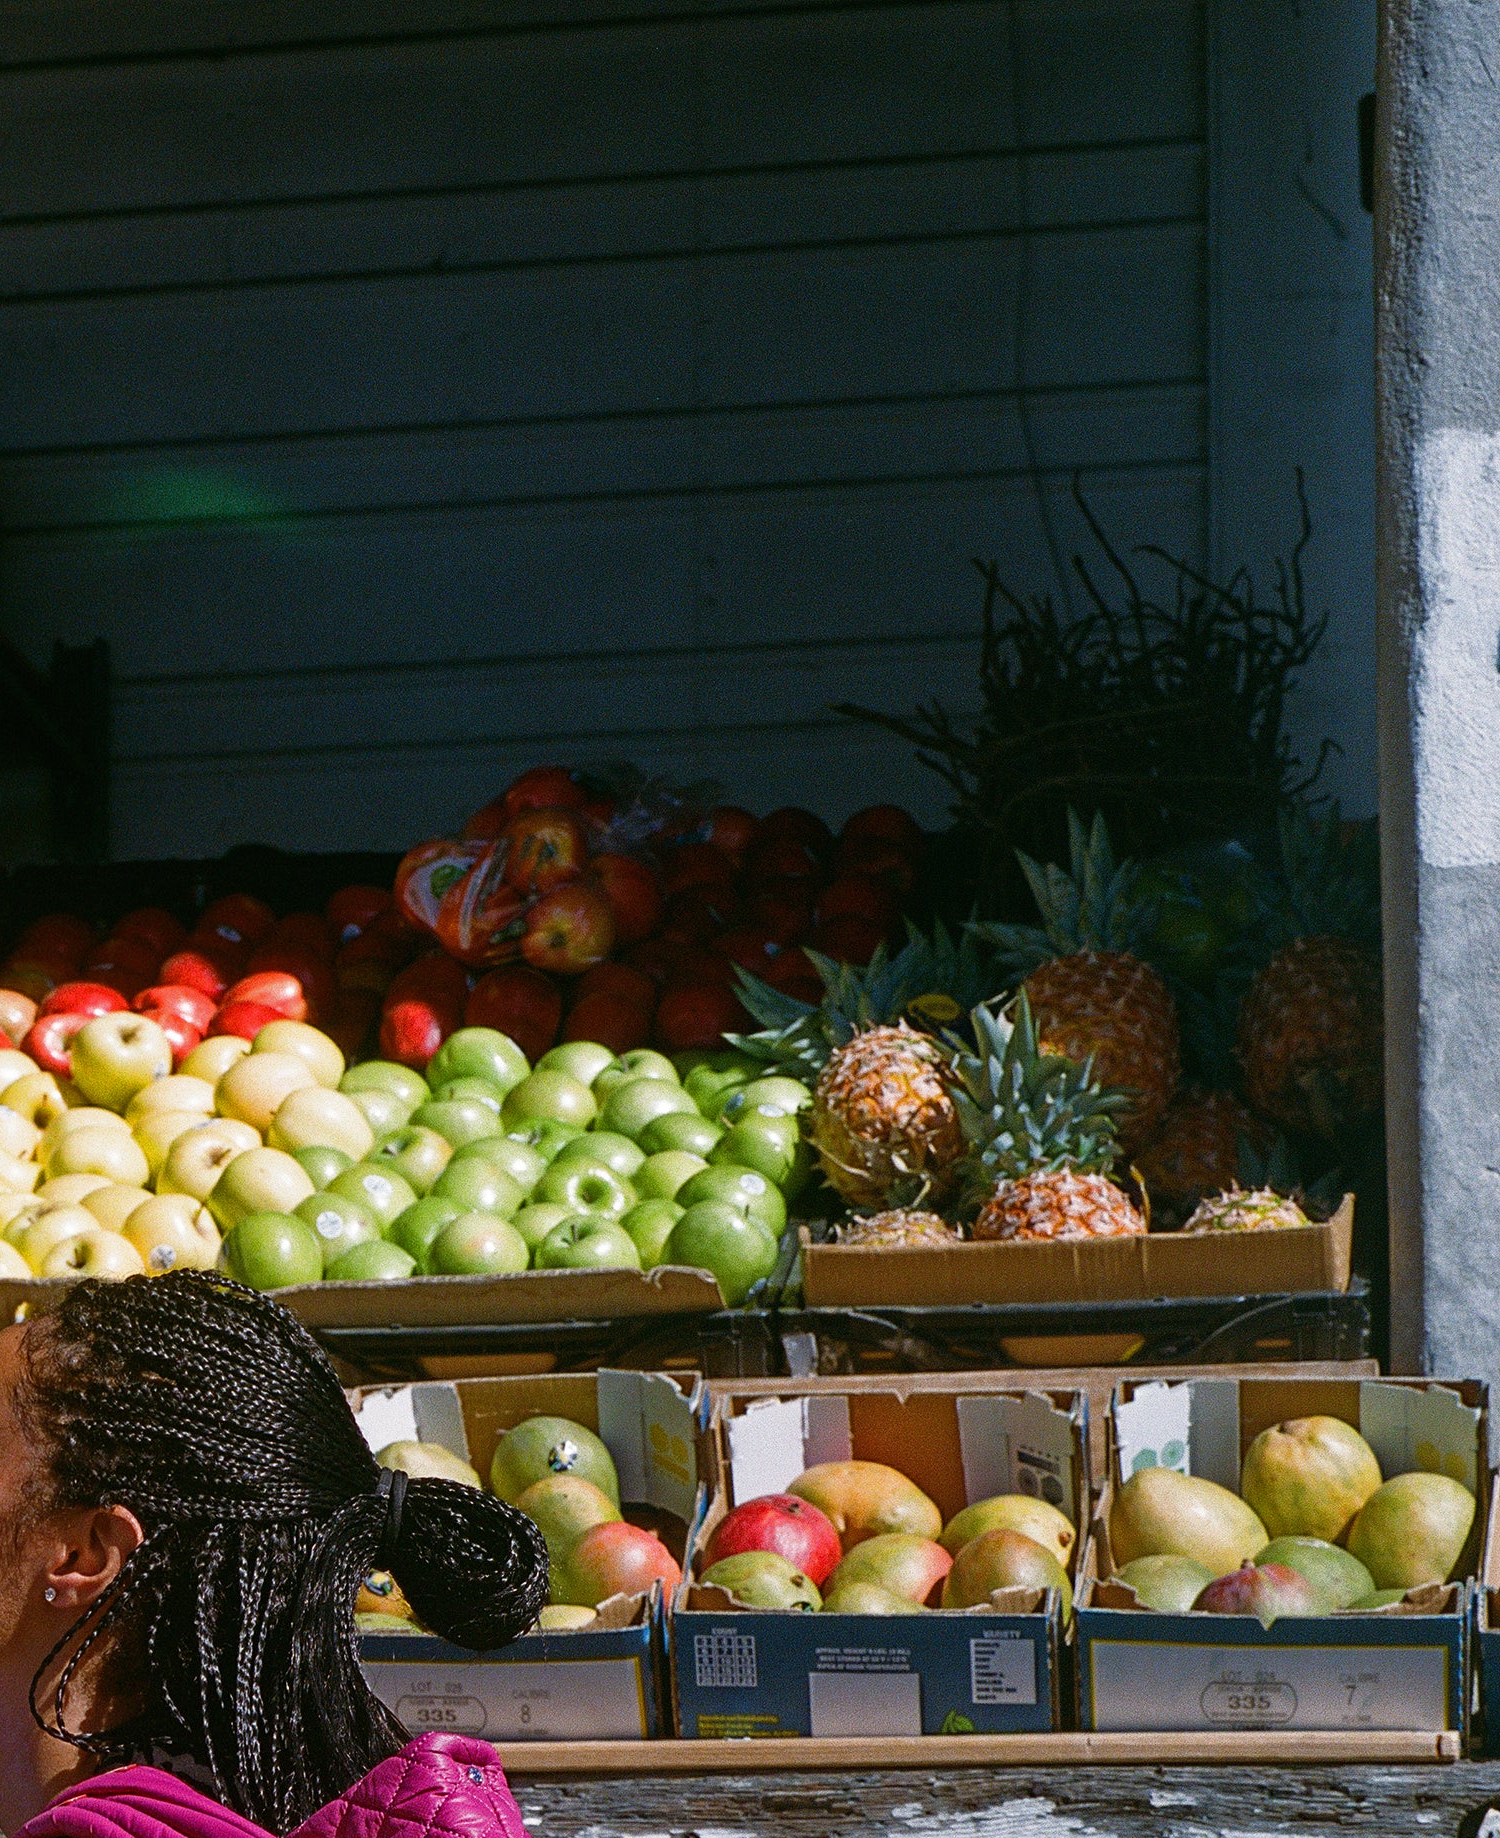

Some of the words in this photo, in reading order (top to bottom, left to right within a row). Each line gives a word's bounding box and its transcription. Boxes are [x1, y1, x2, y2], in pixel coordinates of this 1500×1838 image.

[1228, 1695, 1271, 1710] 335
[1345, 1684, 1357, 1705] 7
[417, 1708, 457, 1722] 335
[520, 1703, 531, 1723] 8
